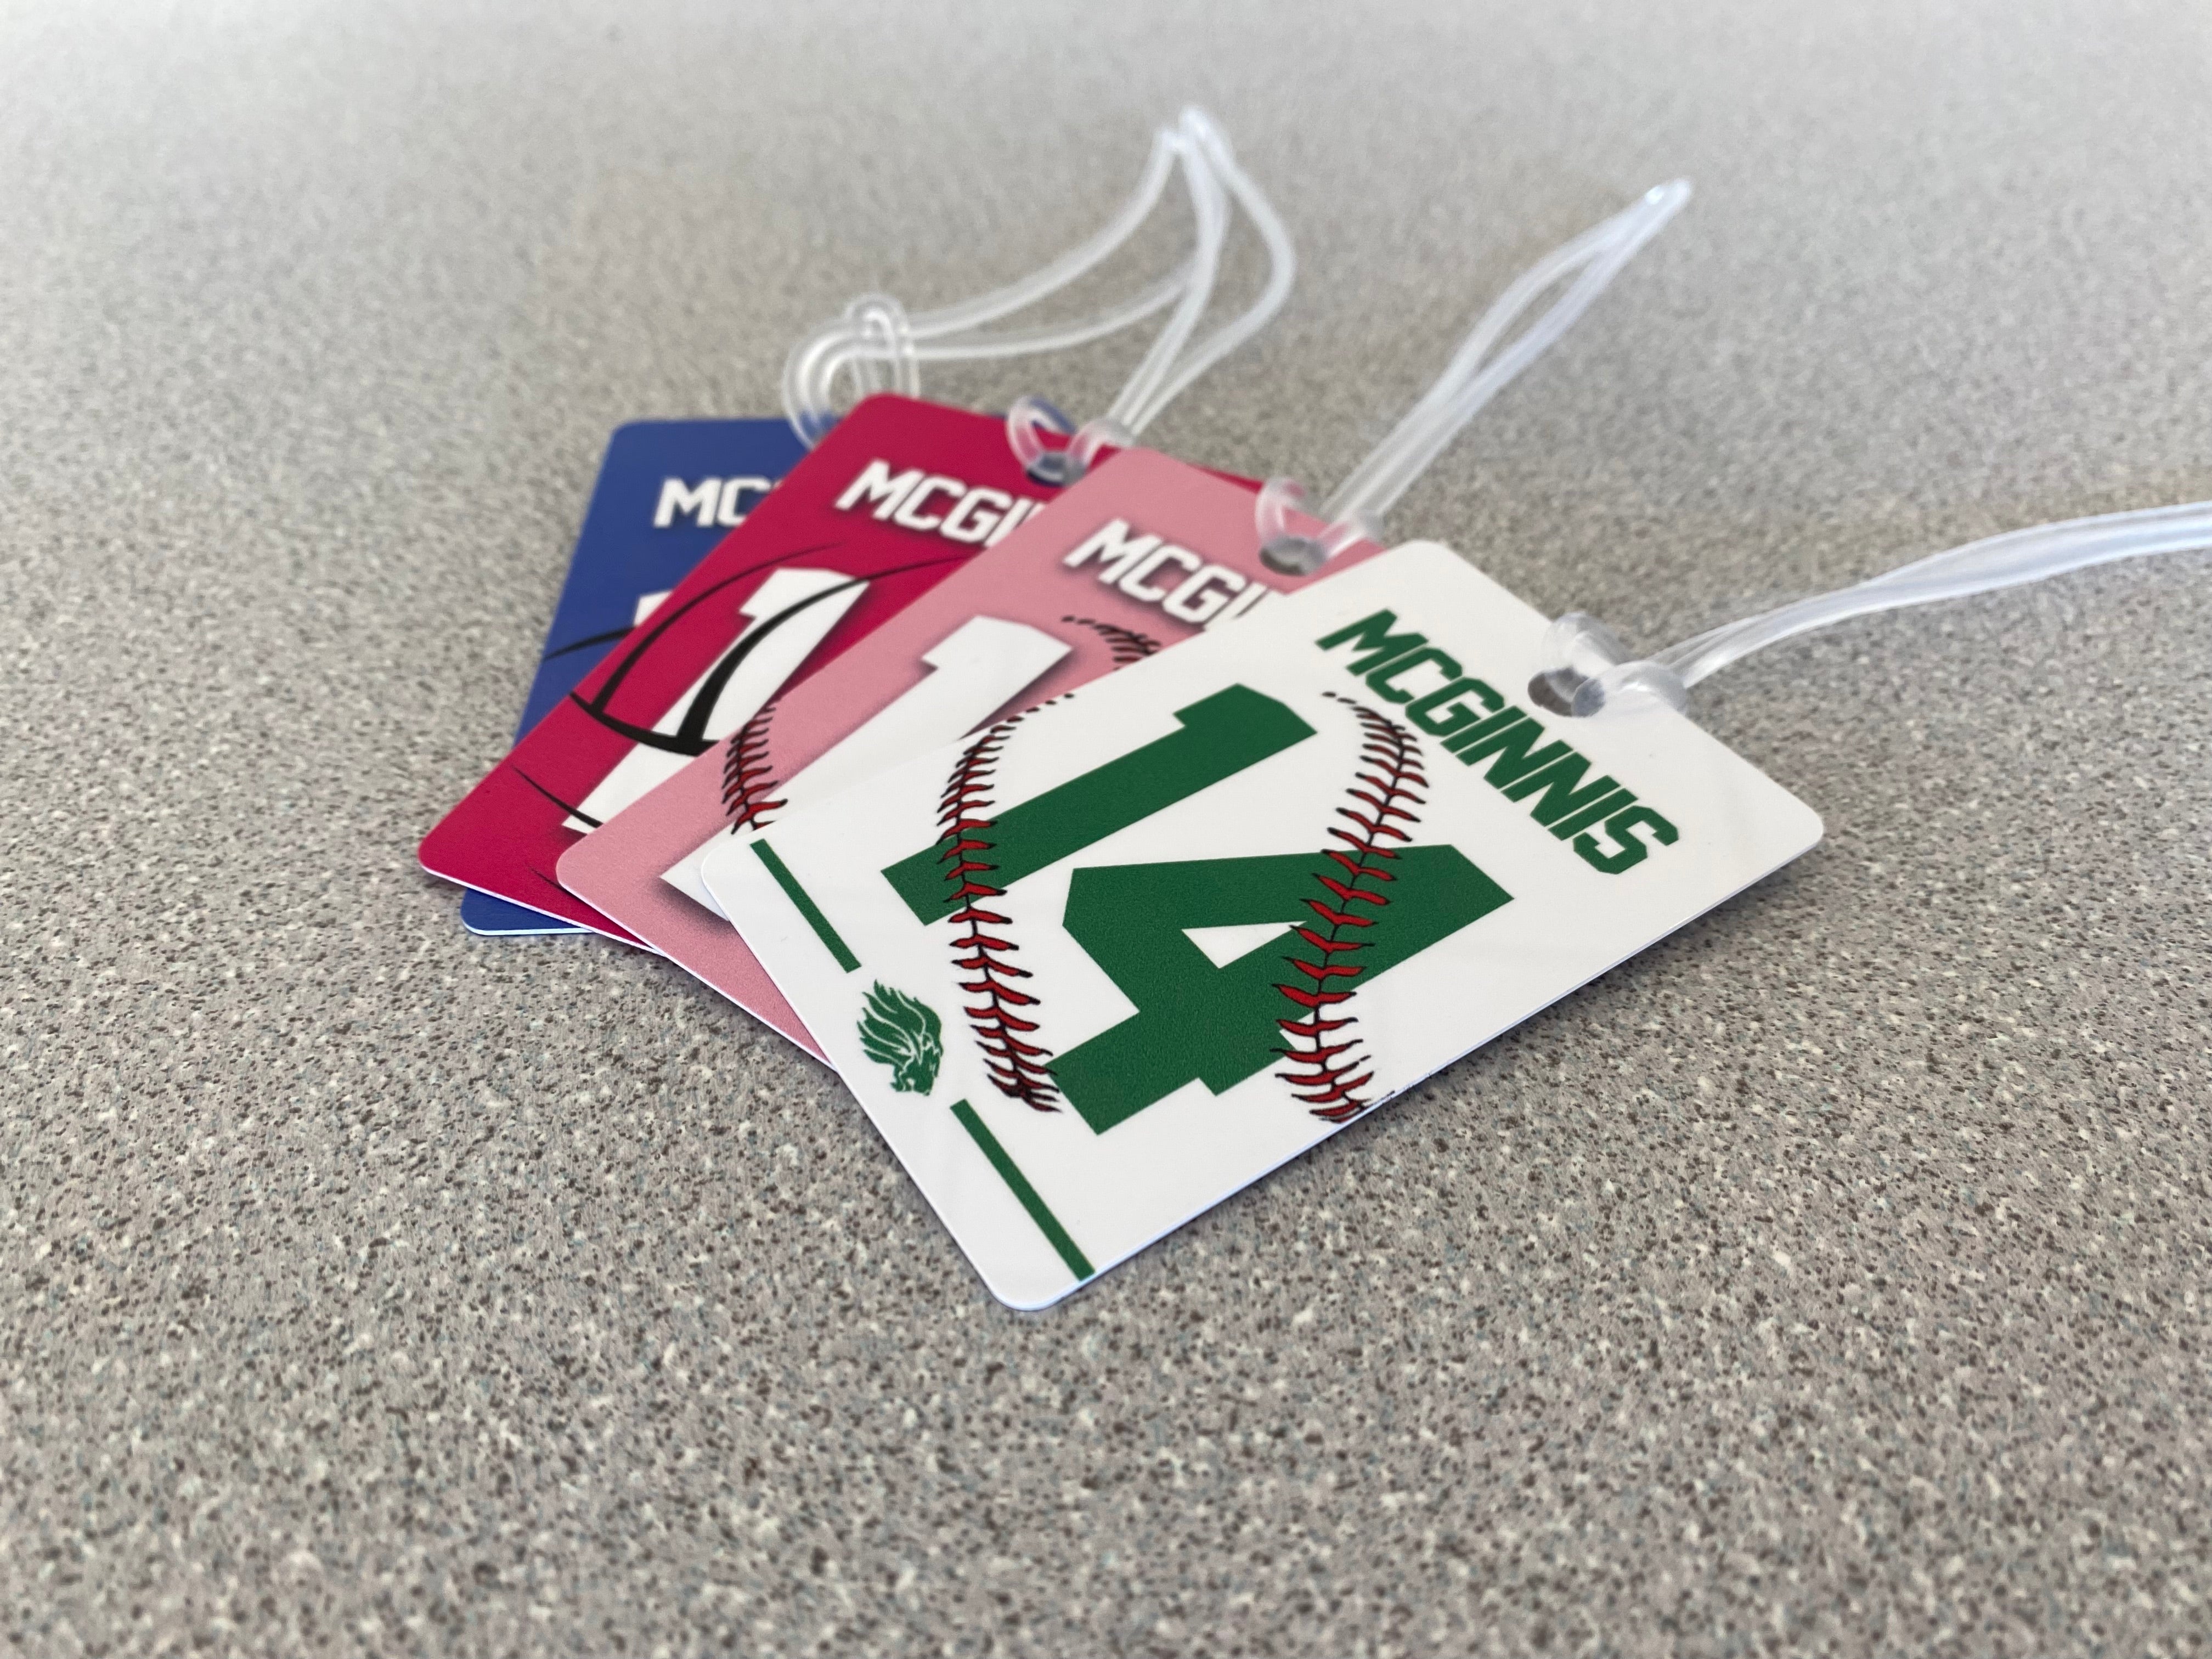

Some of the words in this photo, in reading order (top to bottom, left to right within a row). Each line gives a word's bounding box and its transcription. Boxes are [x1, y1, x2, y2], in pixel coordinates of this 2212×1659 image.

[653, 476, 783, 527] MC
[835, 458, 1047, 548] MCGI
[1314, 608, 1680, 875] MCGINNIS
[881, 682, 1515, 1136] 14
